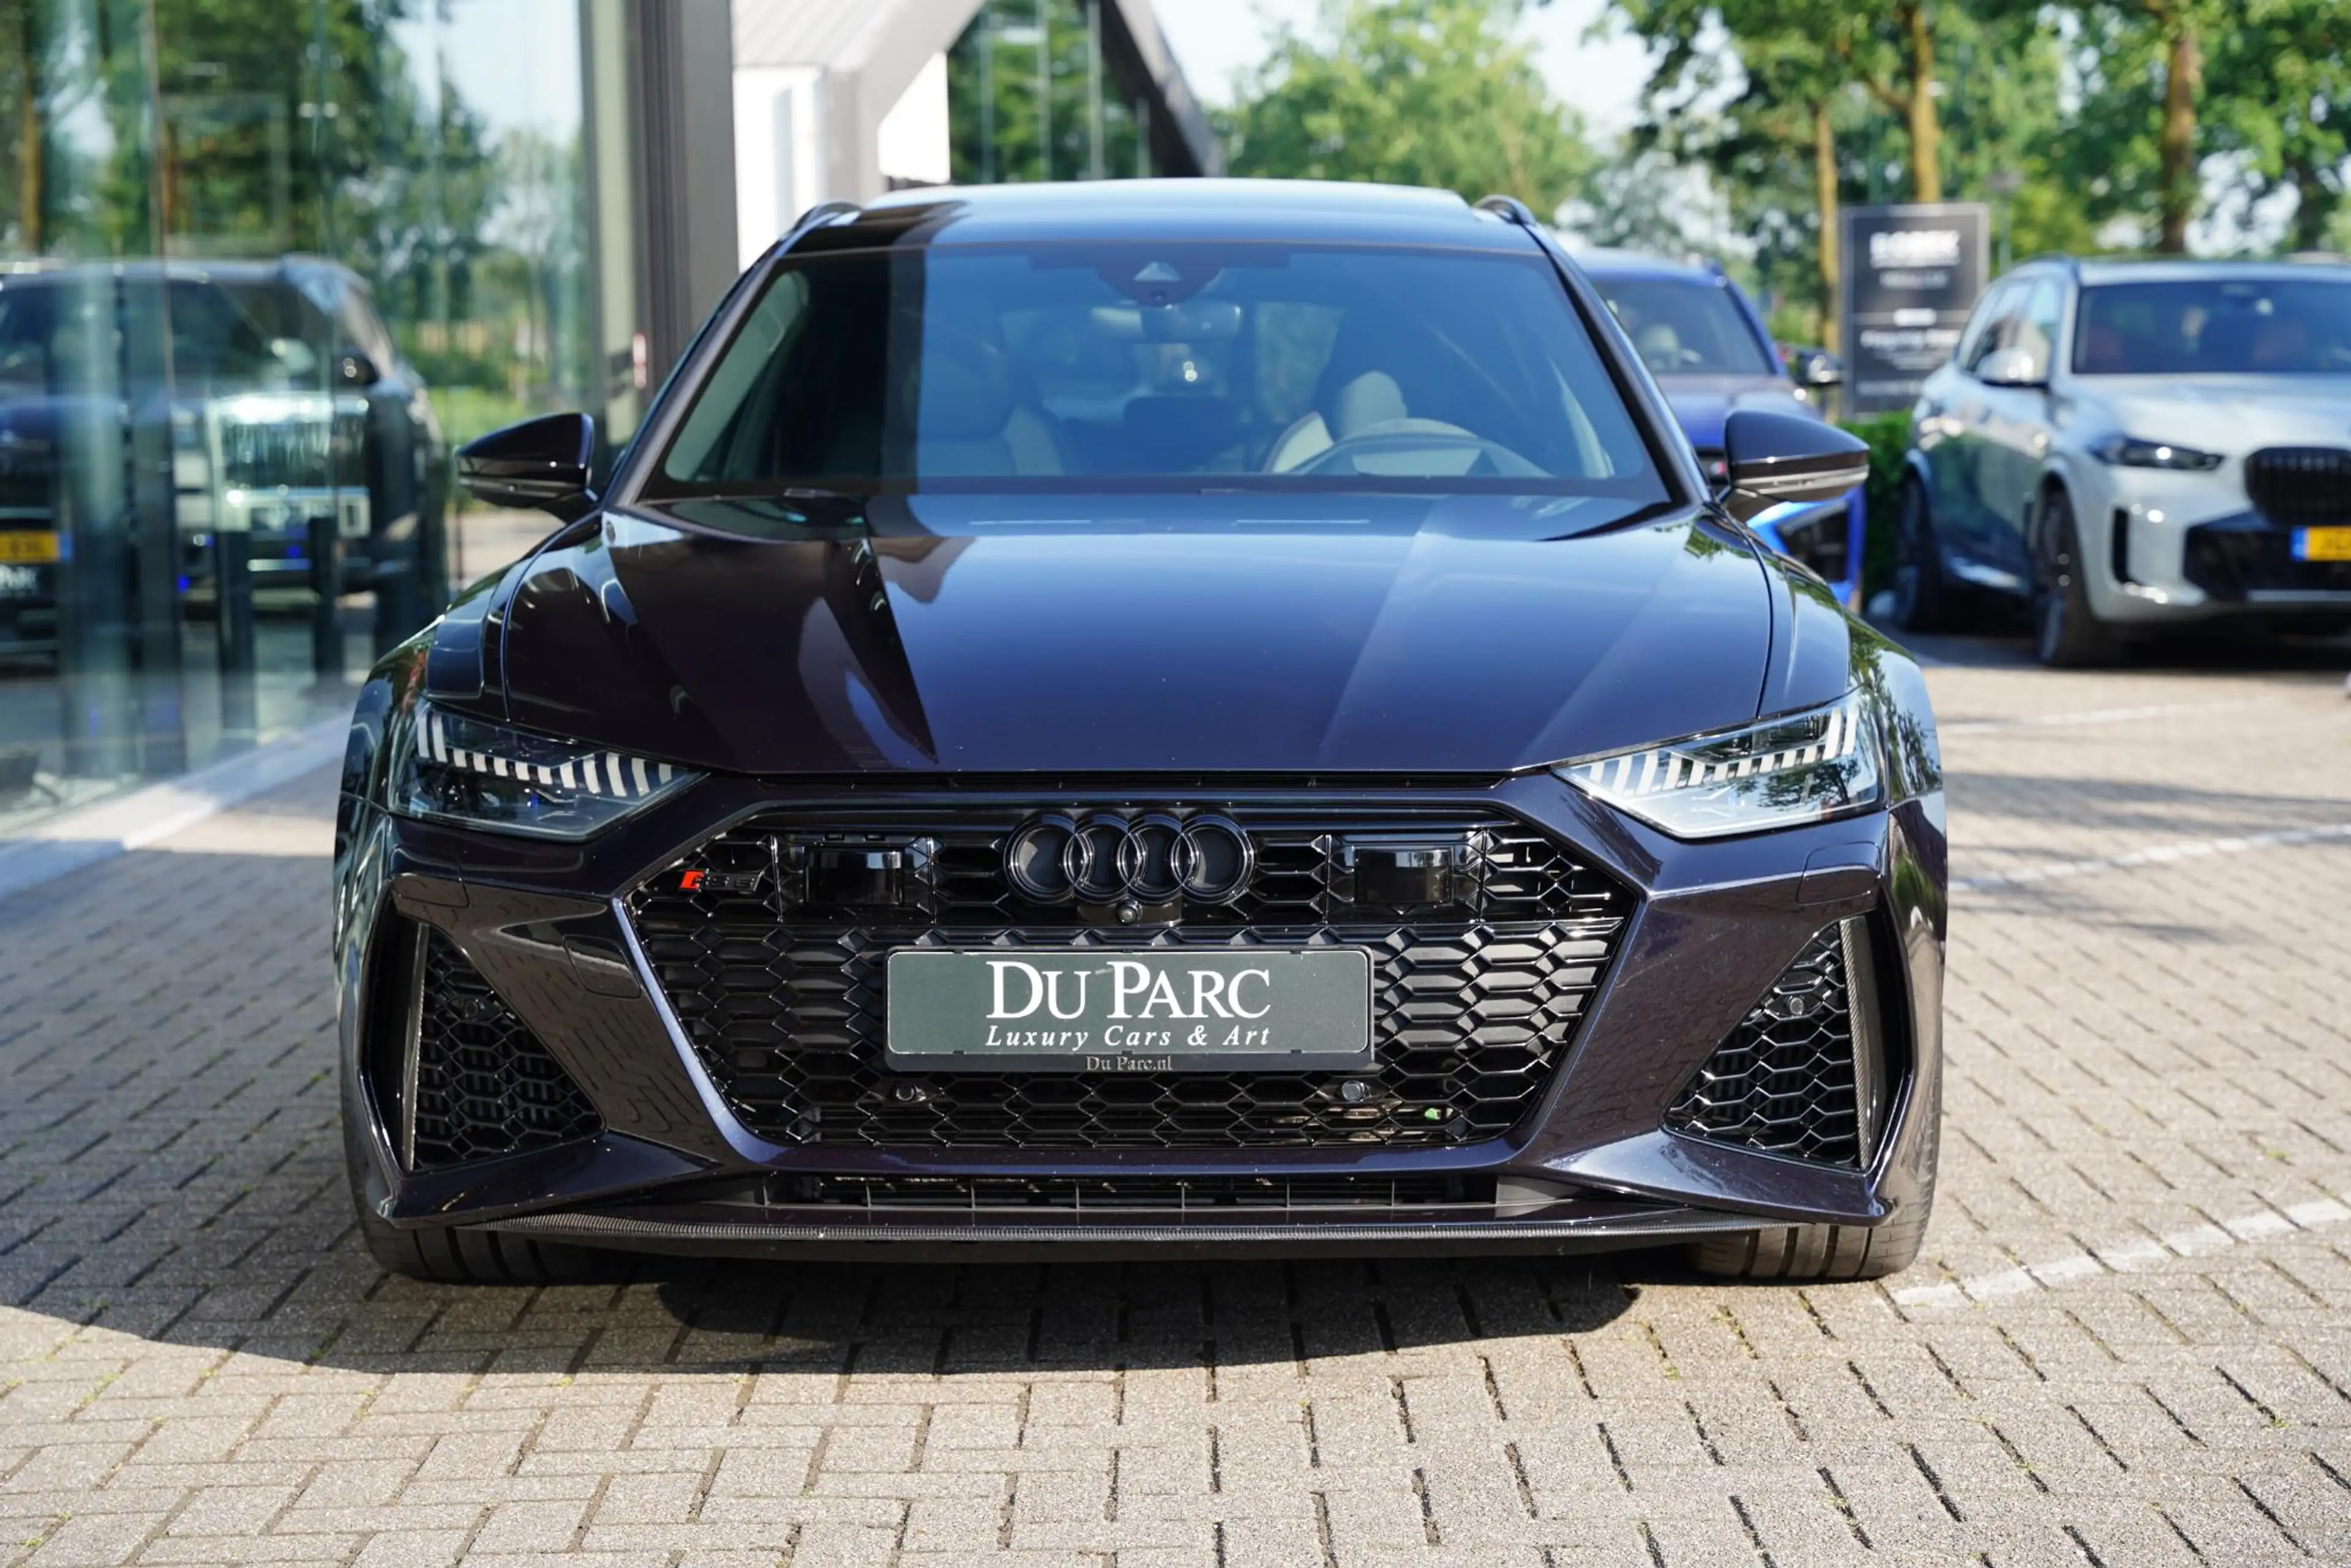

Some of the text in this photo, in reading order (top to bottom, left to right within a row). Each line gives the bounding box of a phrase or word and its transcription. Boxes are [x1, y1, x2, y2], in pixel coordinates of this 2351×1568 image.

[986, 961, 1271, 1019] DU PARC
[985, 1024, 1270, 1052] Luxury Cars & Art
[1086, 1055, 1174, 1071] Du Parc.nl
